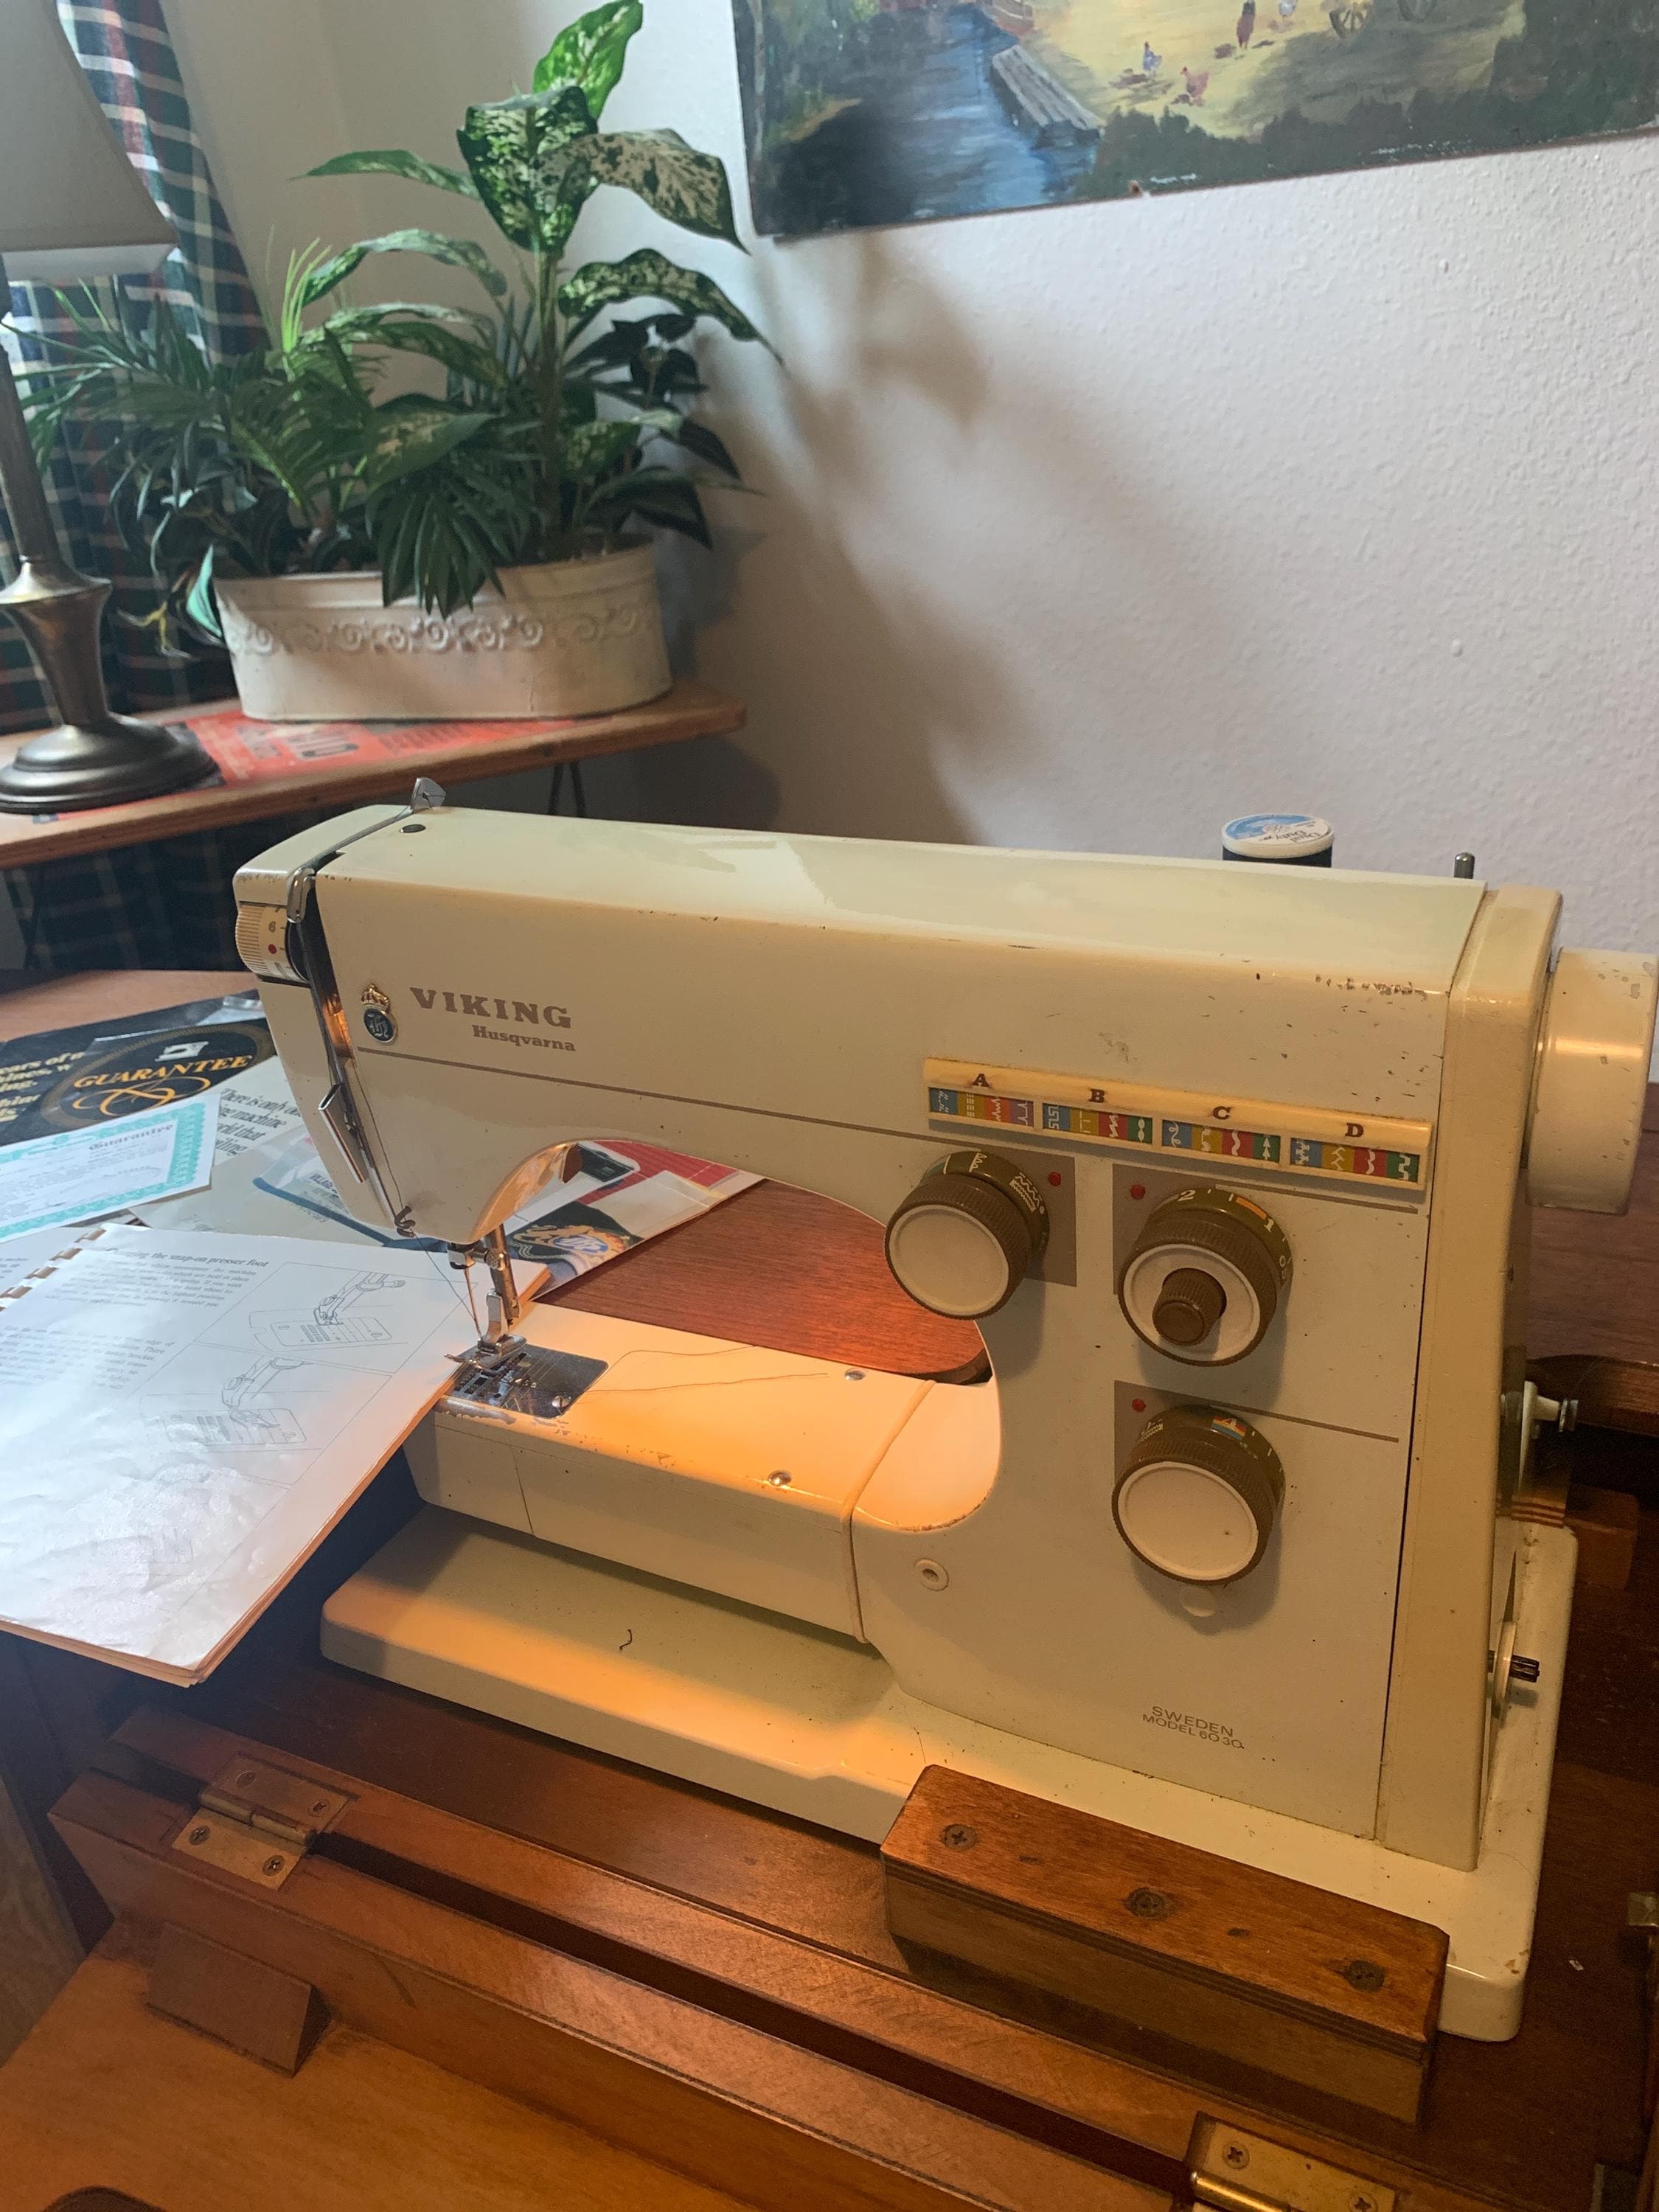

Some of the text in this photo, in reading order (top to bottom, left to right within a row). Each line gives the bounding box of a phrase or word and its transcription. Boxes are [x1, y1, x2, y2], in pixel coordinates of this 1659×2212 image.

[410, 987, 571, 1029] VIKING
[472, 1024, 576, 1052] Husqvarna
[74, 1055, 252, 1088] GUARANTEE
[973, 1074, 1364, 1138] A B C D
[1178, 1189, 1196, 1202] 2
[1264, 1218, 1274, 1233] 1
[246, 1259, 269, 1267] foot
[1143, 1714, 1197, 1736] MODEL
[1152, 1705, 1233, 1737] SWEDEN
